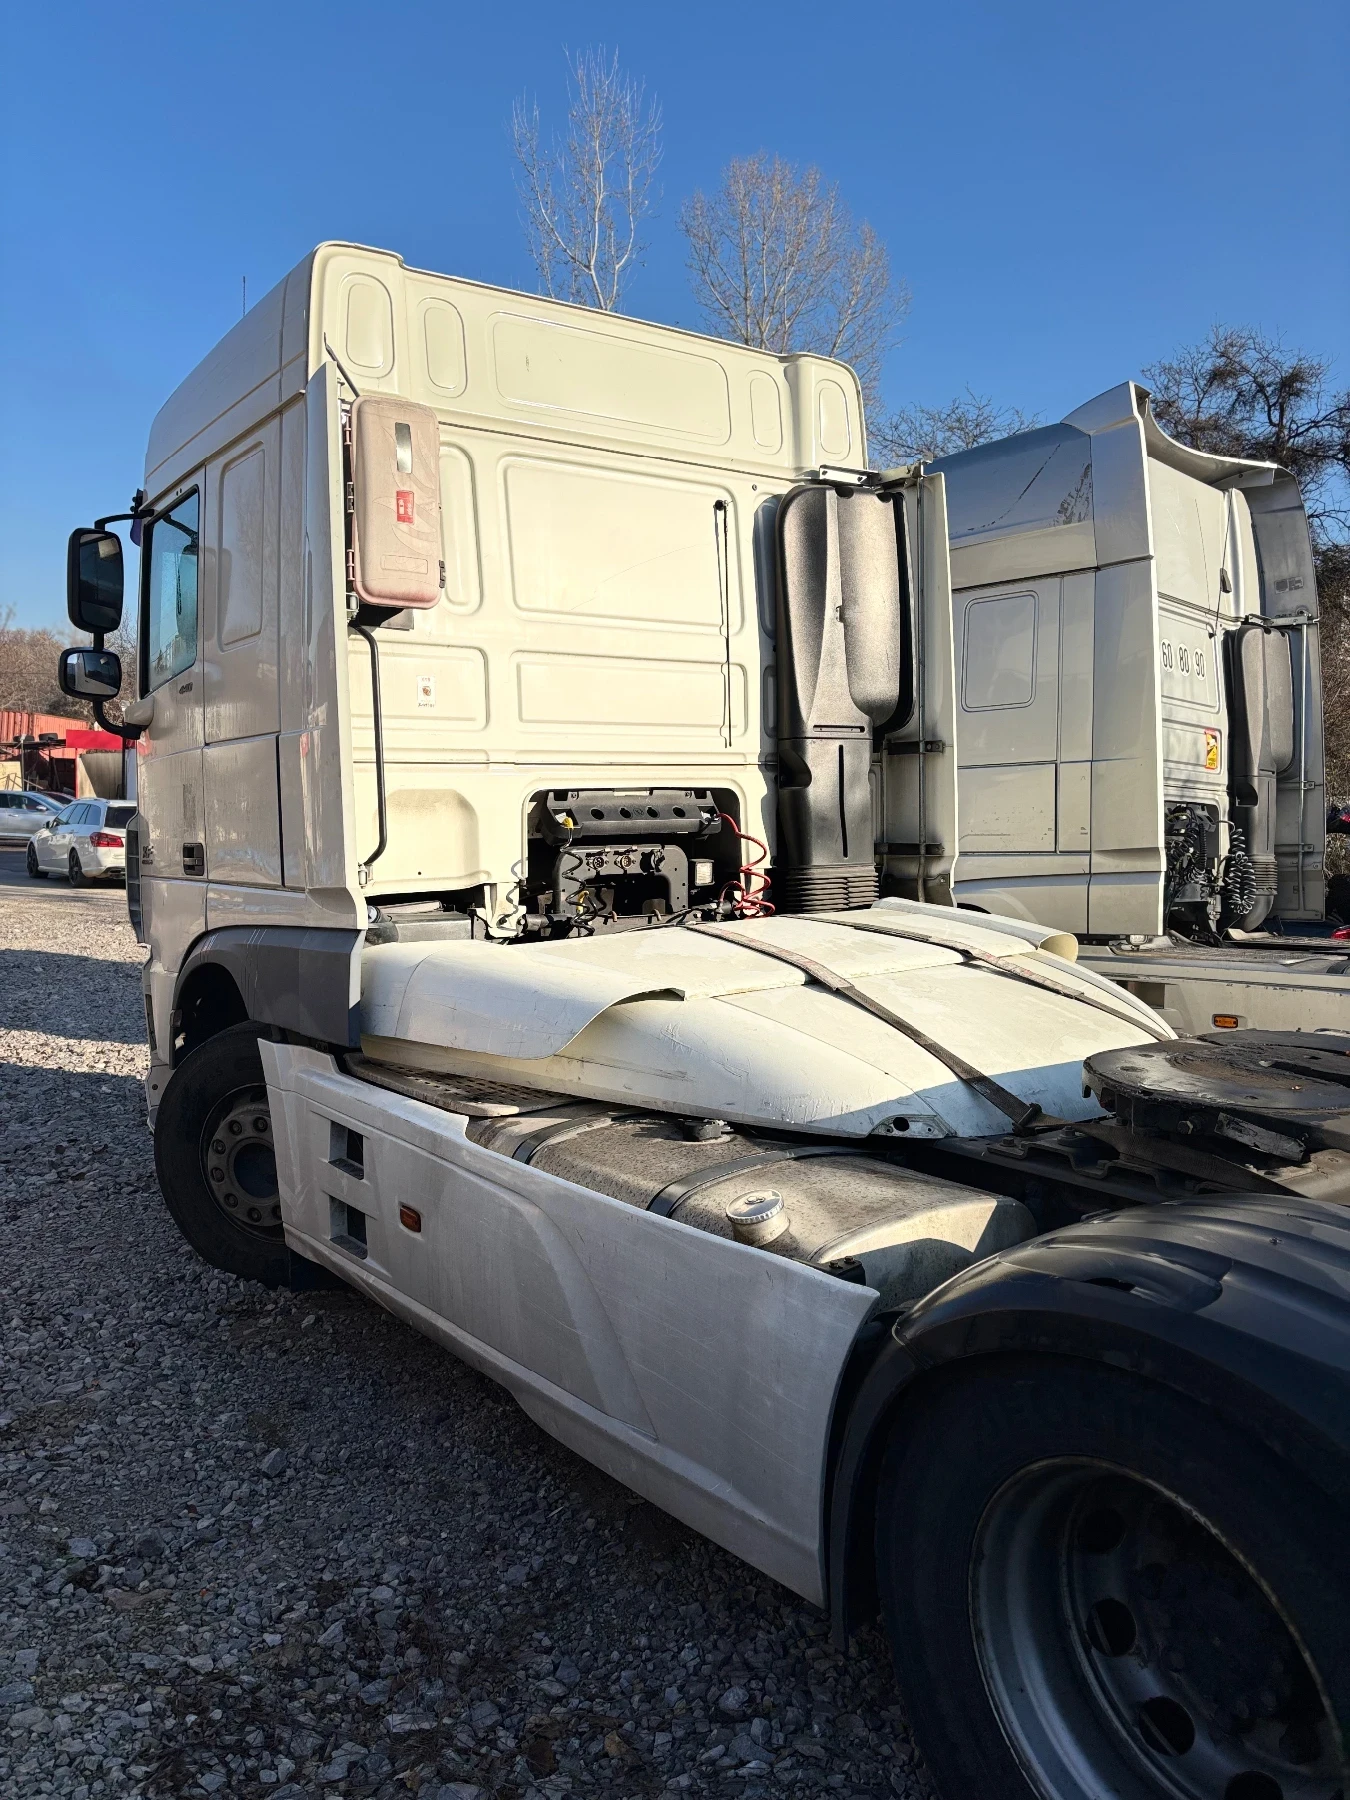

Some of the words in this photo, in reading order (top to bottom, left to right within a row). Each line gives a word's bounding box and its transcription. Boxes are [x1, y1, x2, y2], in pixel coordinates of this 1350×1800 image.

[1161, 641, 1173, 669] 60
[1178, 646, 1190, 674] 80
[1194, 651, 1205, 678] 90
